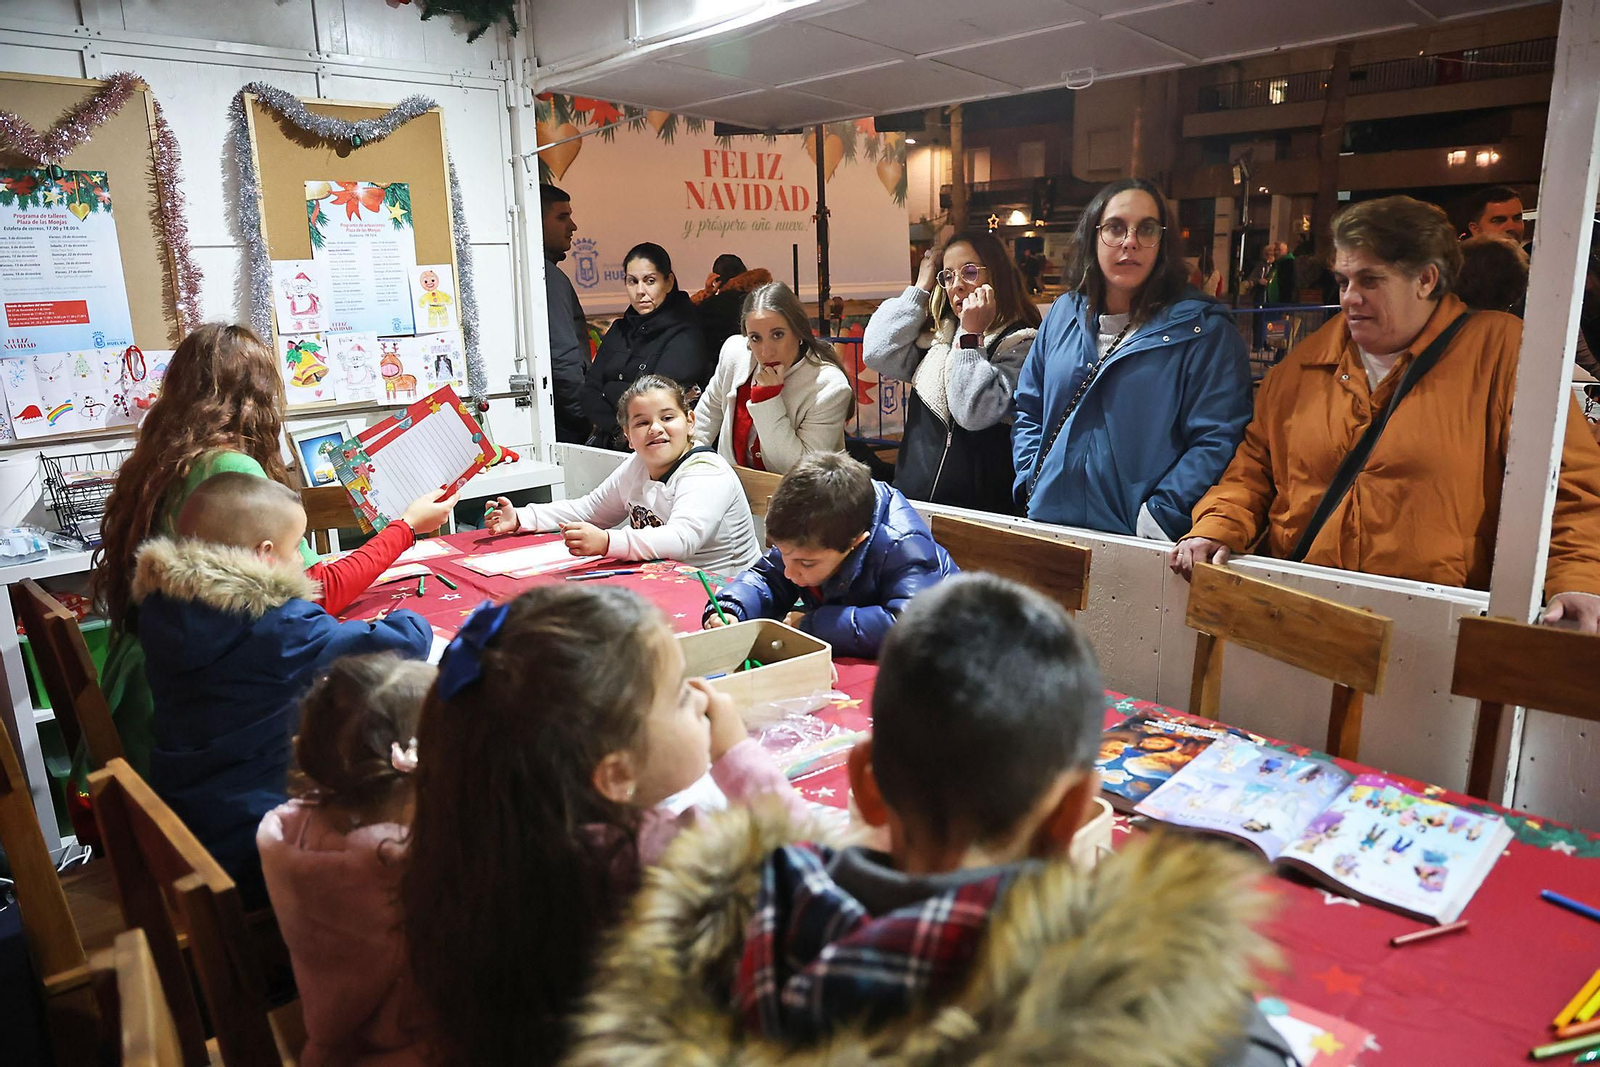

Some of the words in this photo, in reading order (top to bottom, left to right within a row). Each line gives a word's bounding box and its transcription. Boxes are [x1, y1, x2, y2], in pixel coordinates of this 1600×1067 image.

[703, 149, 784, 180] FELIZ
[684, 181, 810, 211] NAVIDAD
[683, 219, 693, 239] y
[696, 215, 746, 238] próspero
[751, 217, 771, 231] año
